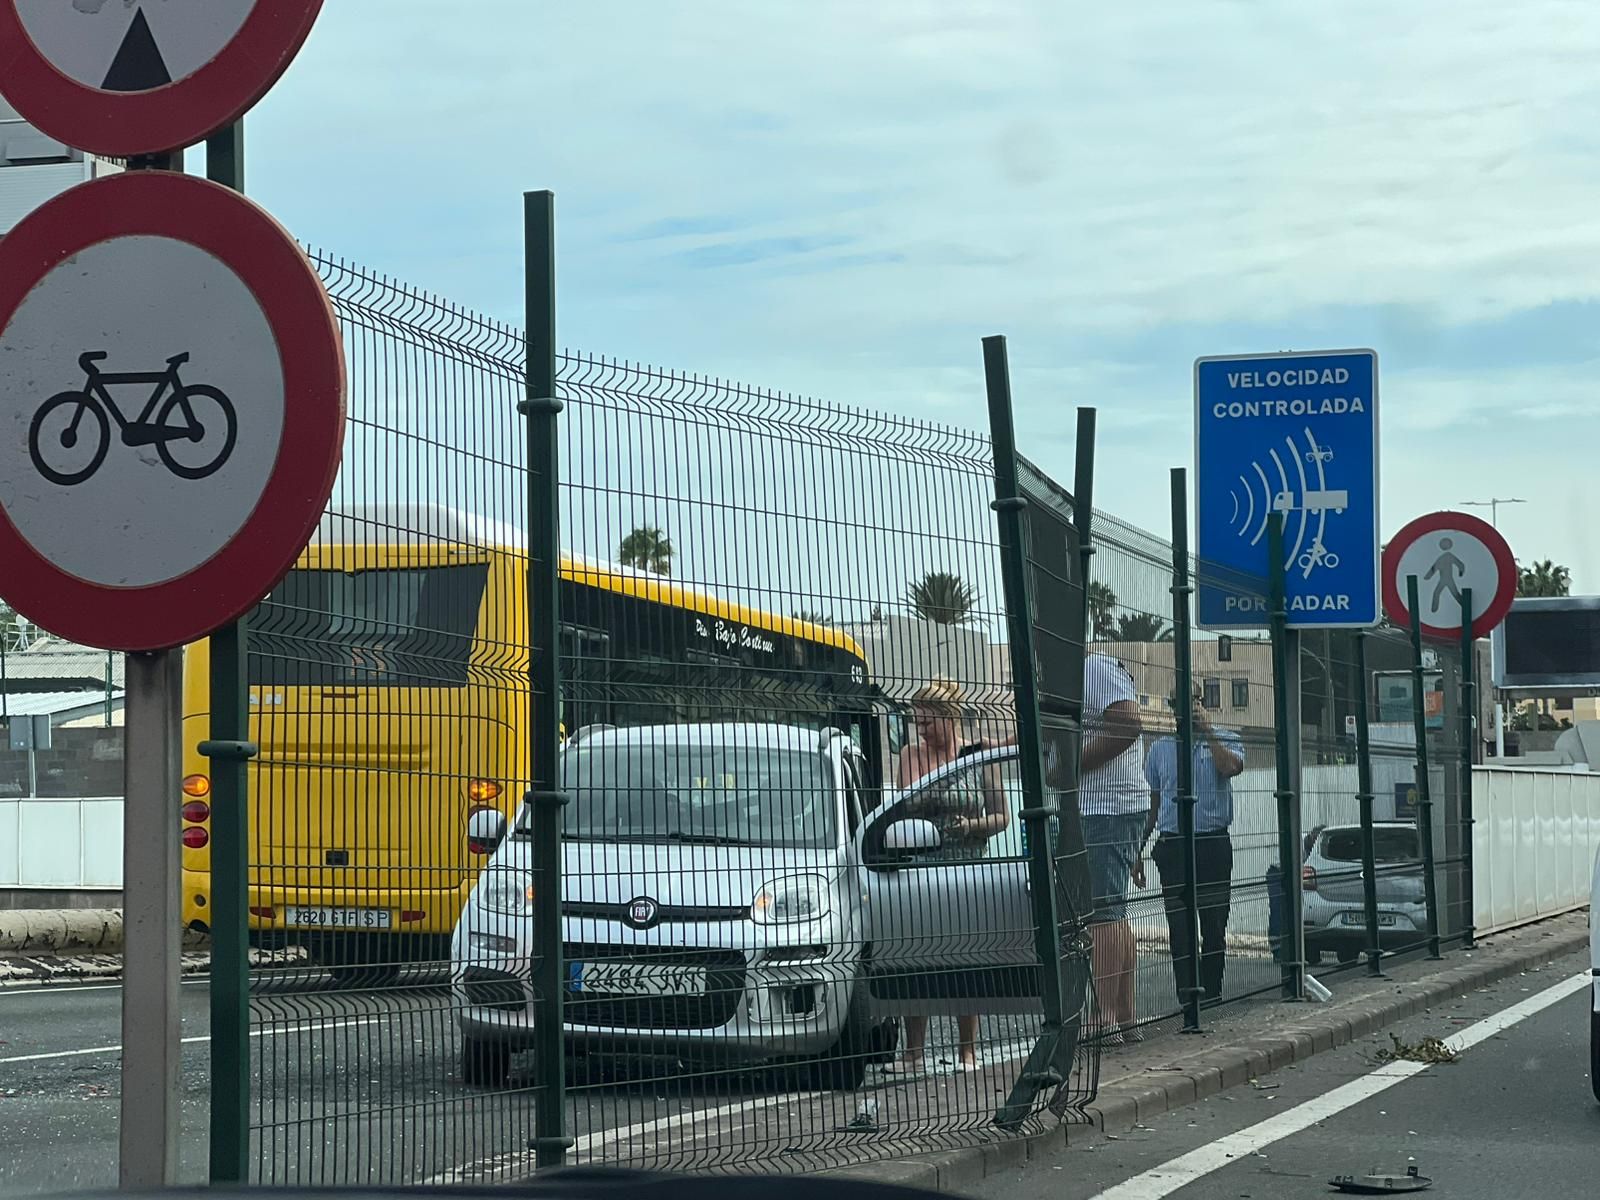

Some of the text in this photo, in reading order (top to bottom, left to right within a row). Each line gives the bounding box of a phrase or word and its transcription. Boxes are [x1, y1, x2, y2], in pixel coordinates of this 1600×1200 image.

[1227, 368, 1349, 388] VELOCIDAD
[1213, 397, 1364, 418] CONTROLADA
[1225, 595, 1267, 612] POR
[295, 911, 326, 923] 2620
[331, 911, 356, 924] GTF
